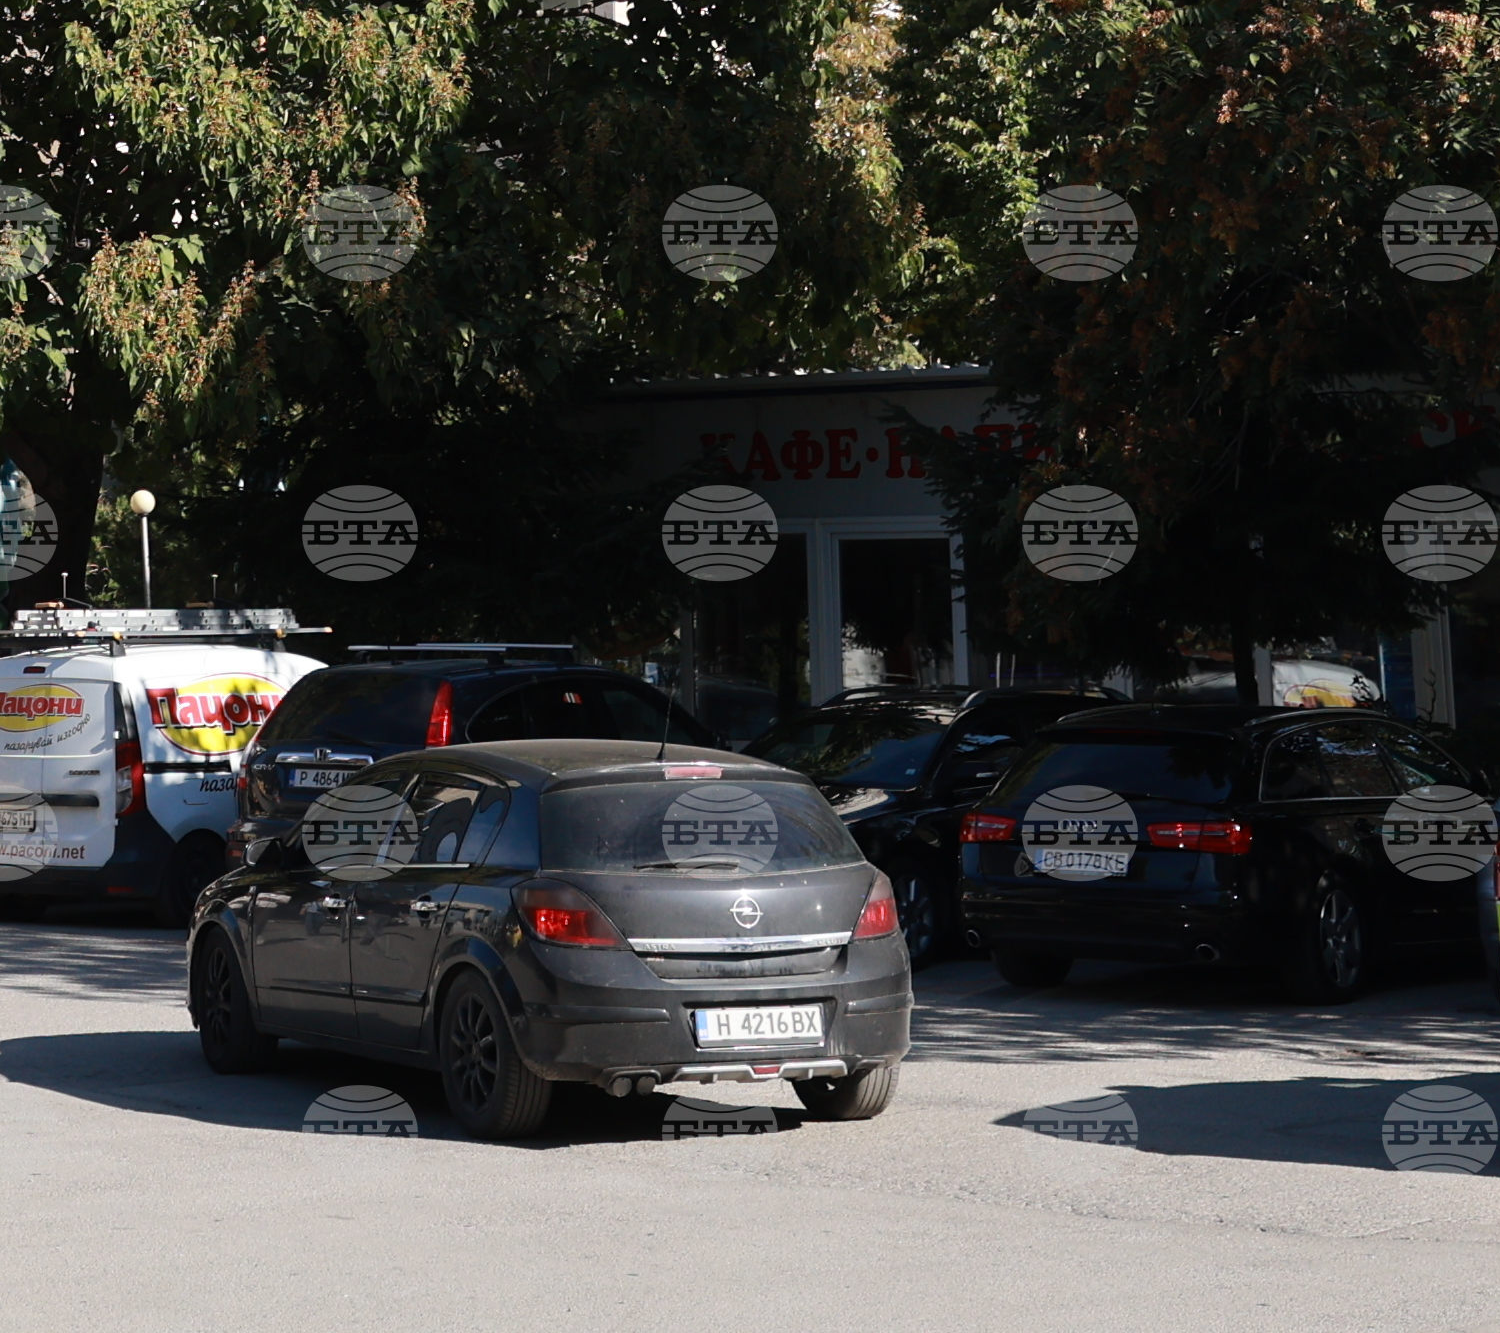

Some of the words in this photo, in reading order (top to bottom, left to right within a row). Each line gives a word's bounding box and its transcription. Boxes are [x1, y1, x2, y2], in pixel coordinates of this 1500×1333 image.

[300, 771, 308, 783] P
[313, 771, 339, 786] 4864
[19, 811, 32, 826] HT
[1044, 851, 1063, 868] CB
[1066, 852, 1101, 869] 0178
[717, 1015, 731, 1035] H
[741, 1012, 788, 1034] 4216
[792, 1011, 818, 1033] BX
